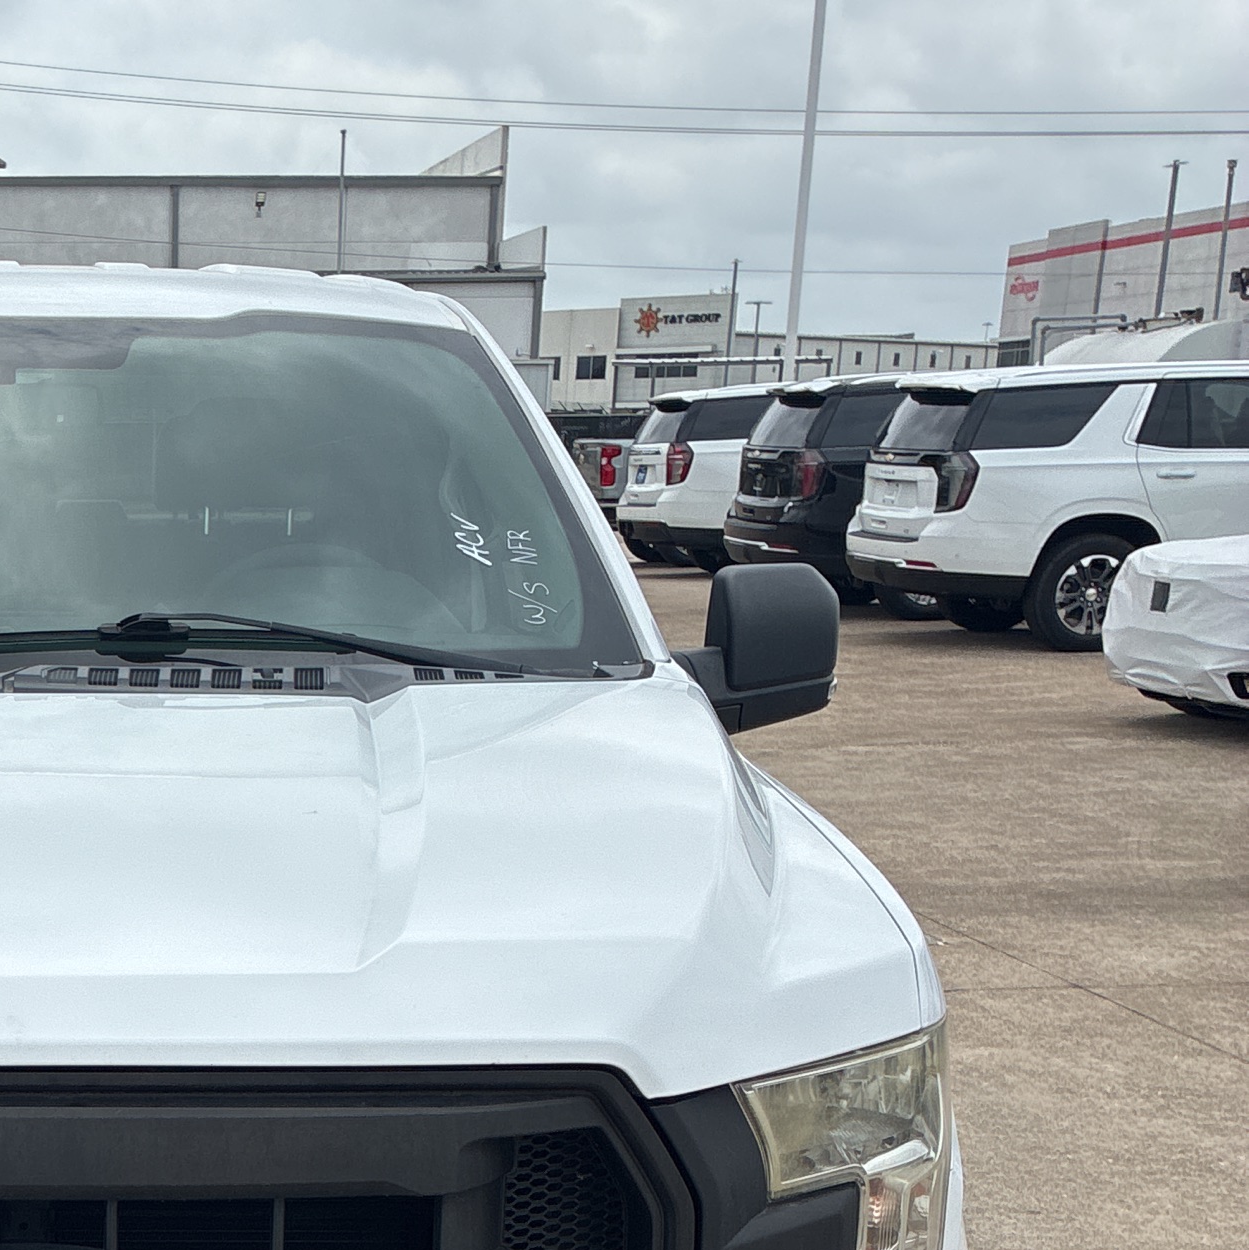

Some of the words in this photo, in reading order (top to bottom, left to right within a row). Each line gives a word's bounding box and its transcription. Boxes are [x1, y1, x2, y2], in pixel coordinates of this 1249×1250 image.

[685, 313, 721, 323] GROUP
[450, 512, 492, 566] ACV
[507, 529, 538, 565] NFR
[507, 581, 558, 625] W/S
